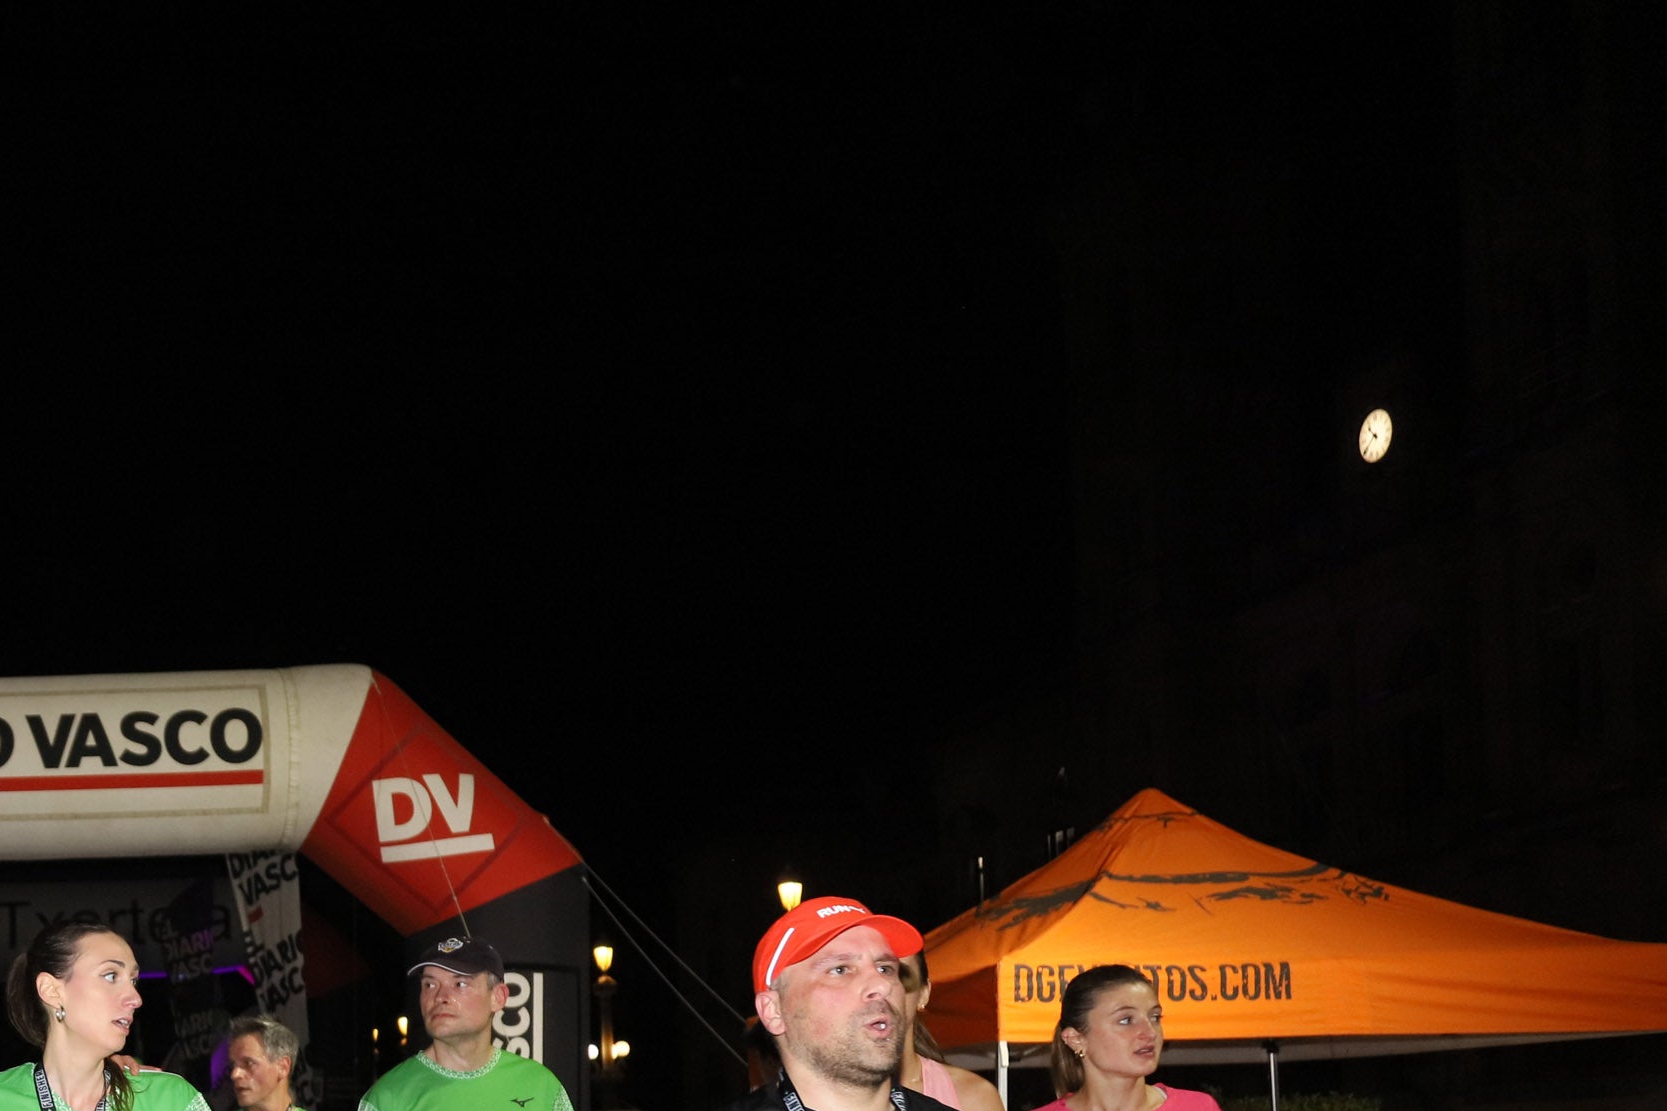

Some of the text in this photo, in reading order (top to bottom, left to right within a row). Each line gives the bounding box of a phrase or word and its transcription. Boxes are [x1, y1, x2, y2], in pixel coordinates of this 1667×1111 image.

[25, 707, 263, 770] VASCO
[372, 772, 476, 845] DV
[34, 1070, 53, 1109] FINISHER
